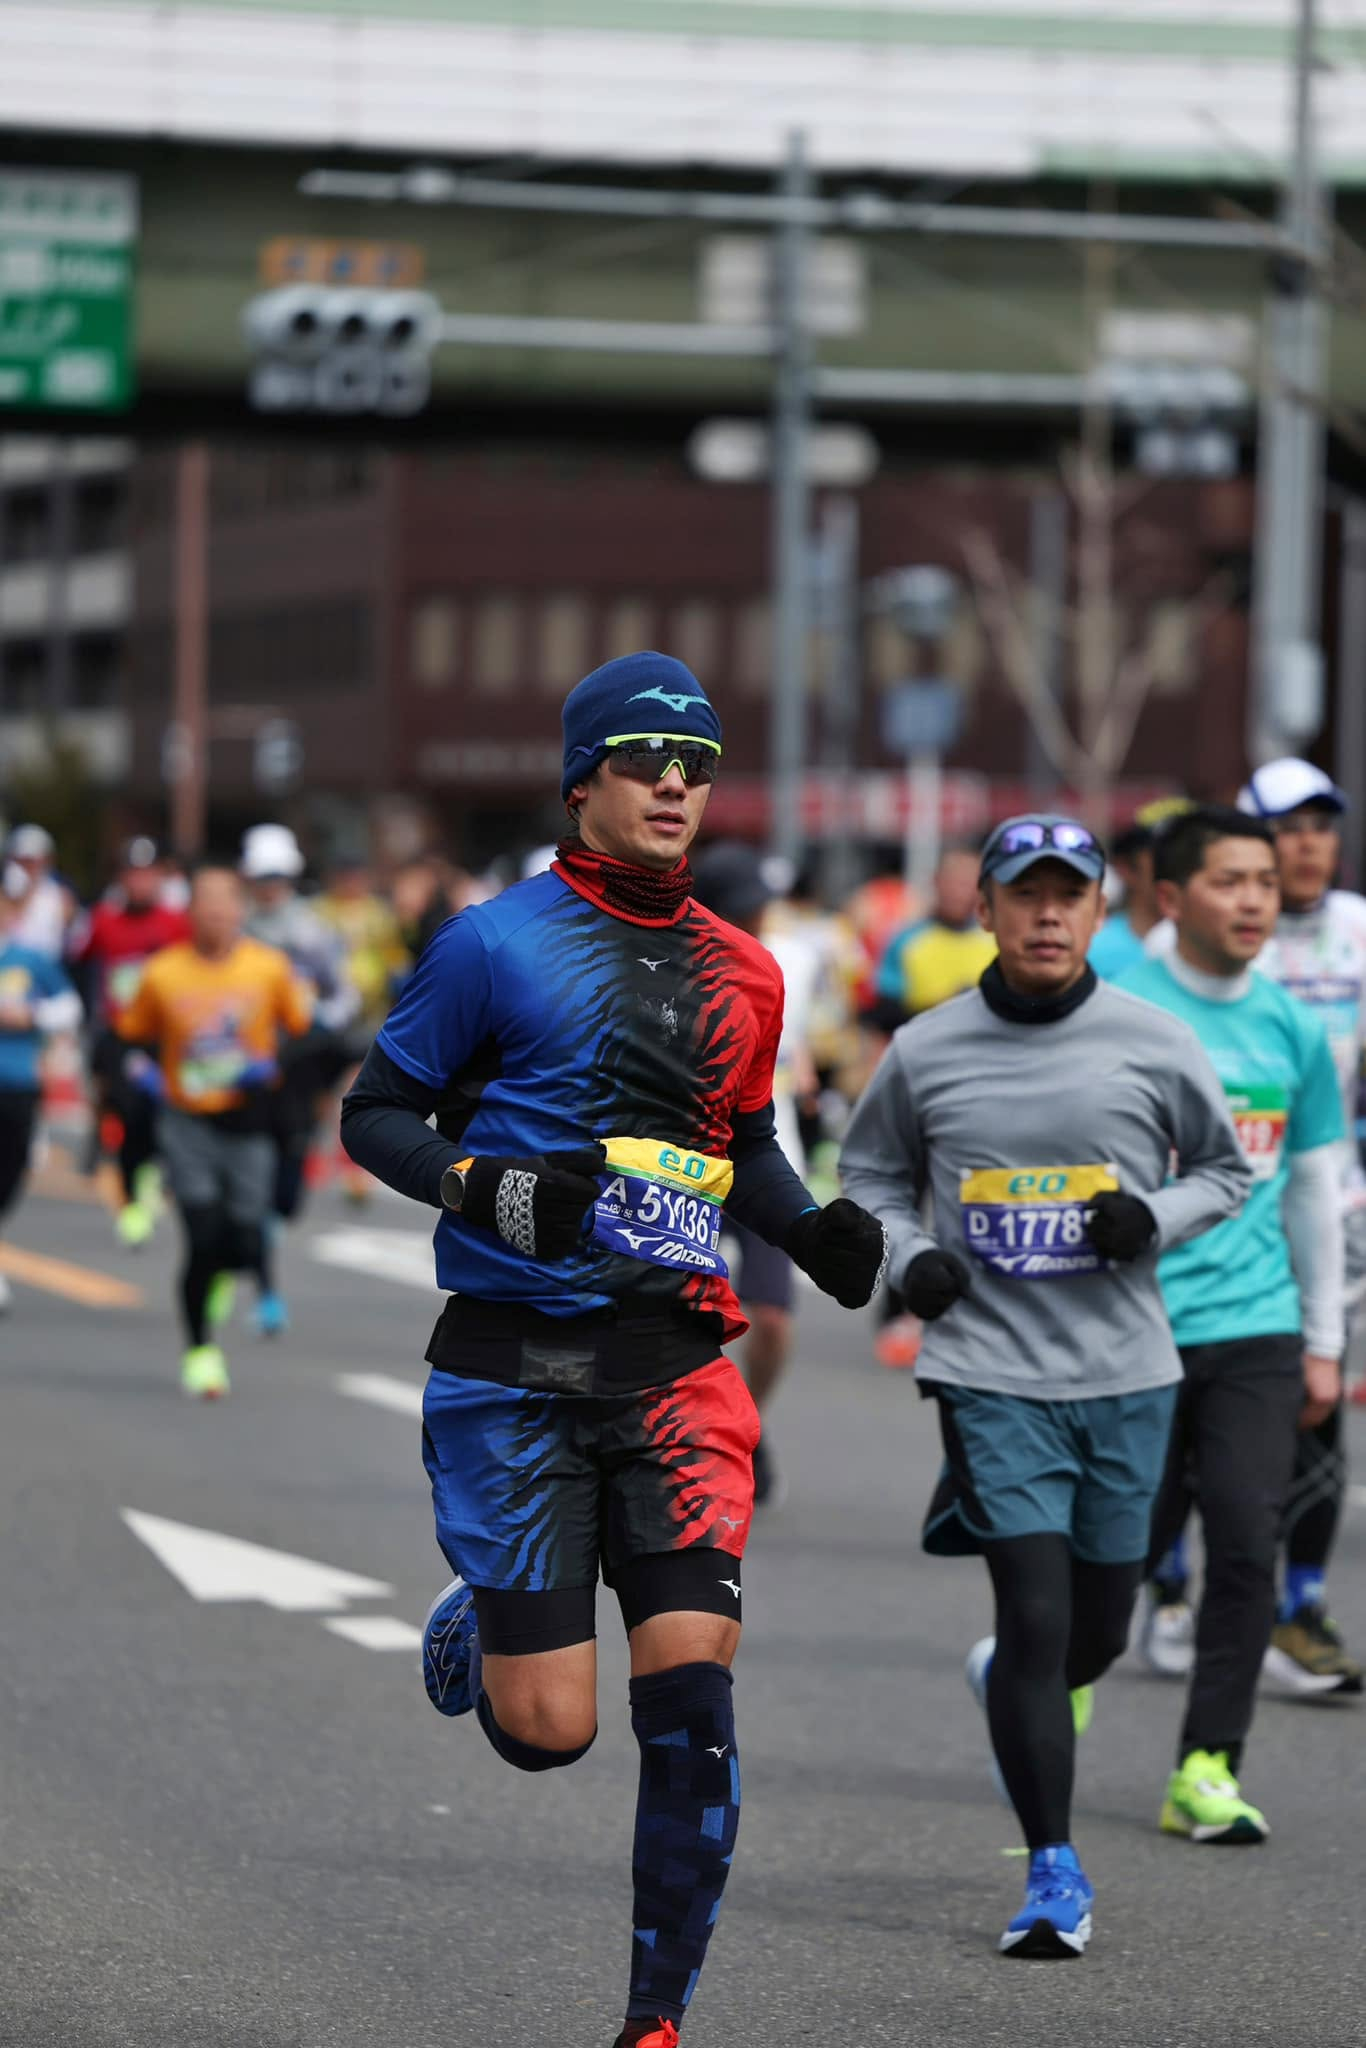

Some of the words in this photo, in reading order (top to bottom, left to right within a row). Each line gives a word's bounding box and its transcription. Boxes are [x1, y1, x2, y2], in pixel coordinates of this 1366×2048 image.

[601, 1177, 627, 1203] A
[968, 1210, 990, 1236] D
[1000, 1209, 1098, 1247] 1778
